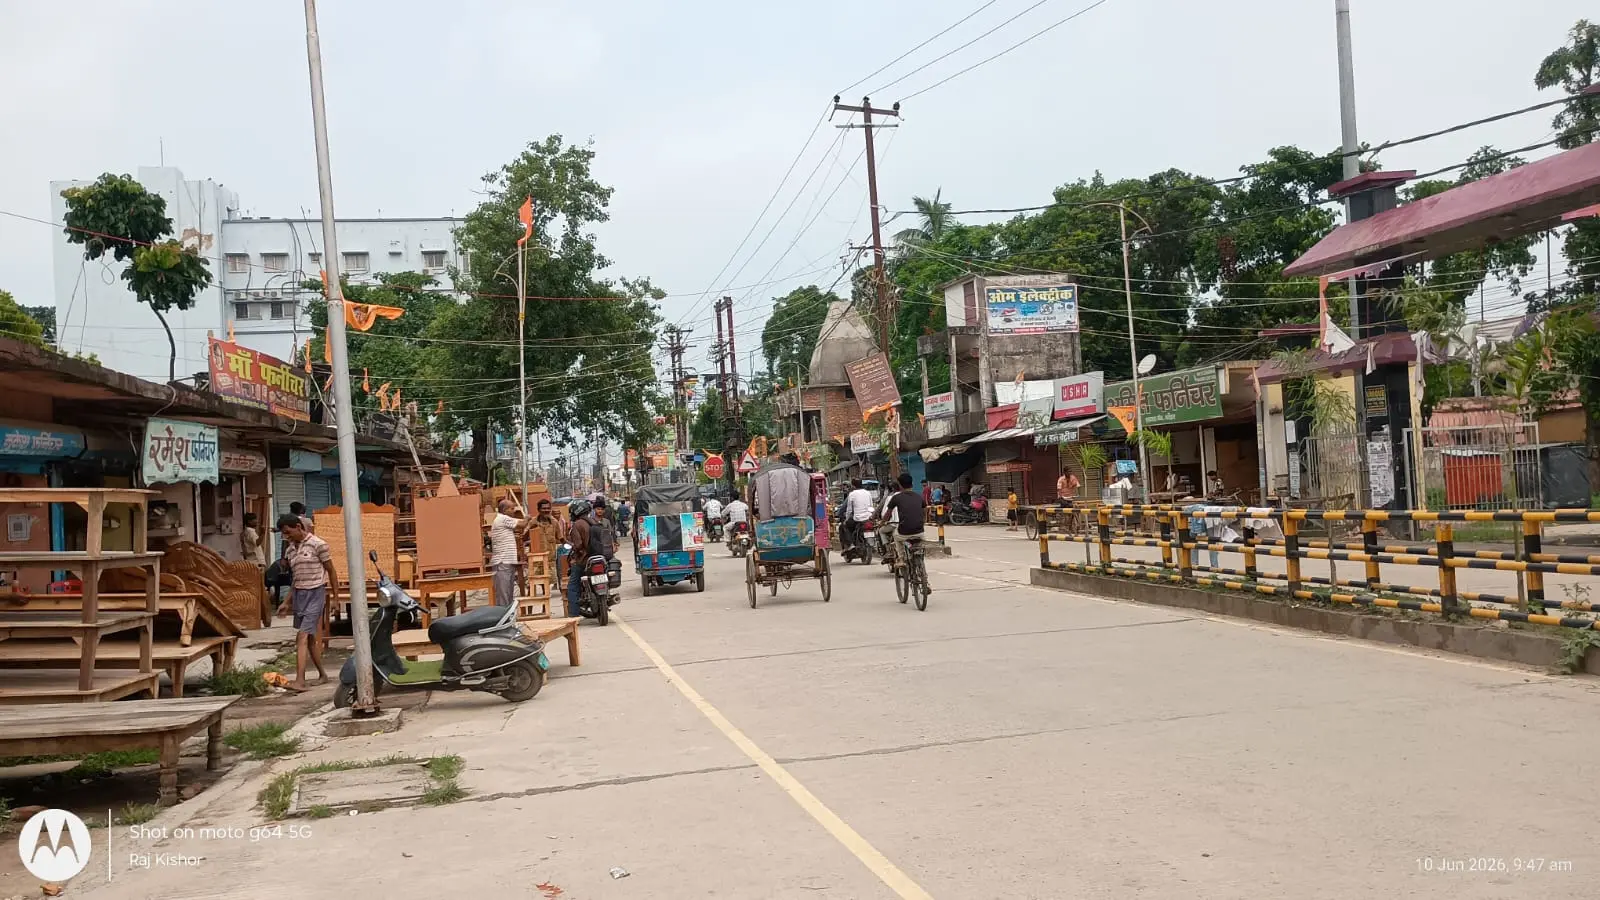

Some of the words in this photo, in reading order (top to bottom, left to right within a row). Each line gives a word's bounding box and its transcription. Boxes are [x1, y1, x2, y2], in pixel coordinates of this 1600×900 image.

[988, 289, 1016, 303] ओम
[259, 363, 305, 397] फर्नीचर
[1062, 384, 1088, 399] USHA
[1152, 376, 1217, 412] फर्निचर
[149, 425, 190, 472] रमेश
